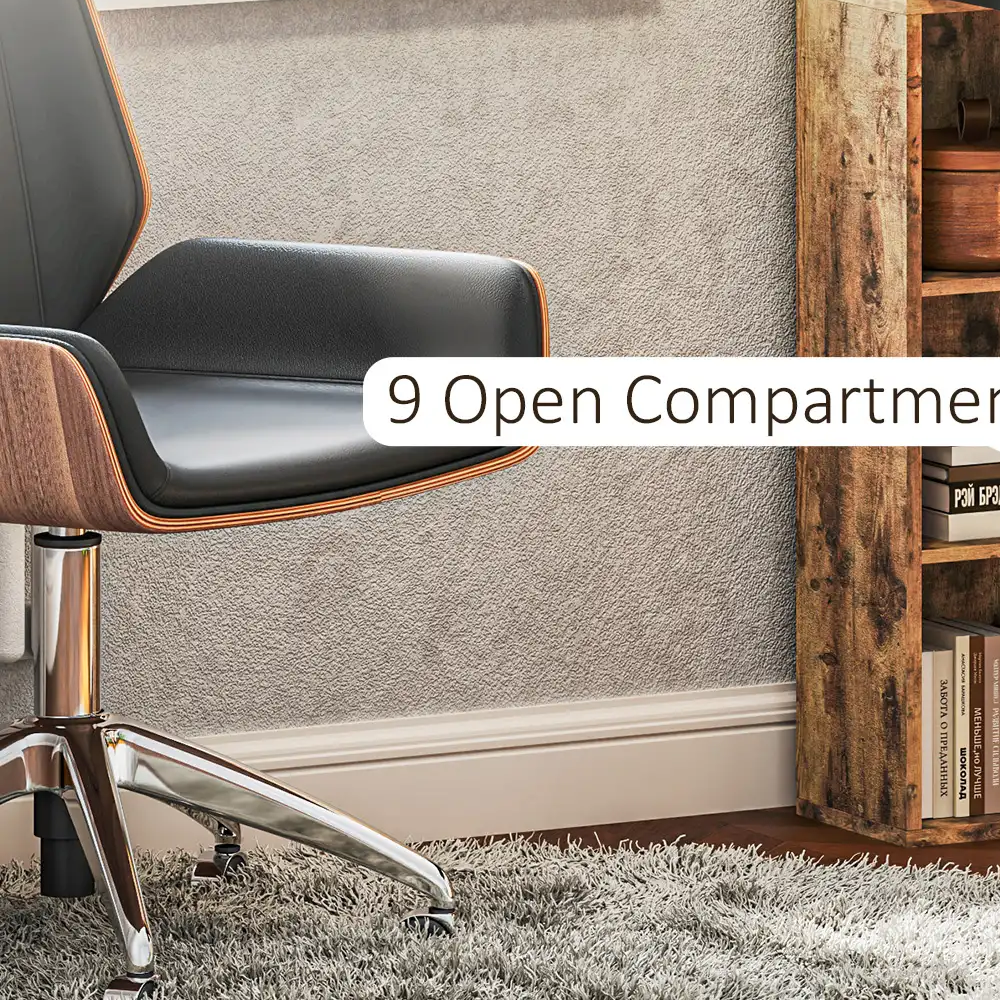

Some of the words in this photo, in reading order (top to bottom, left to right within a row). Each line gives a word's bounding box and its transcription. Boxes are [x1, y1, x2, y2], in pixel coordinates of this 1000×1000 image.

[954, 483, 975, 508] РЭЙ
[940, 679, 948, 718] ЗАБОТА
[939, 732, 948, 797] ПРЕДАННЫХ
[959, 748, 967, 800] ШОКОЛАД
[973, 766, 982, 799] ЛУЧШЕ
